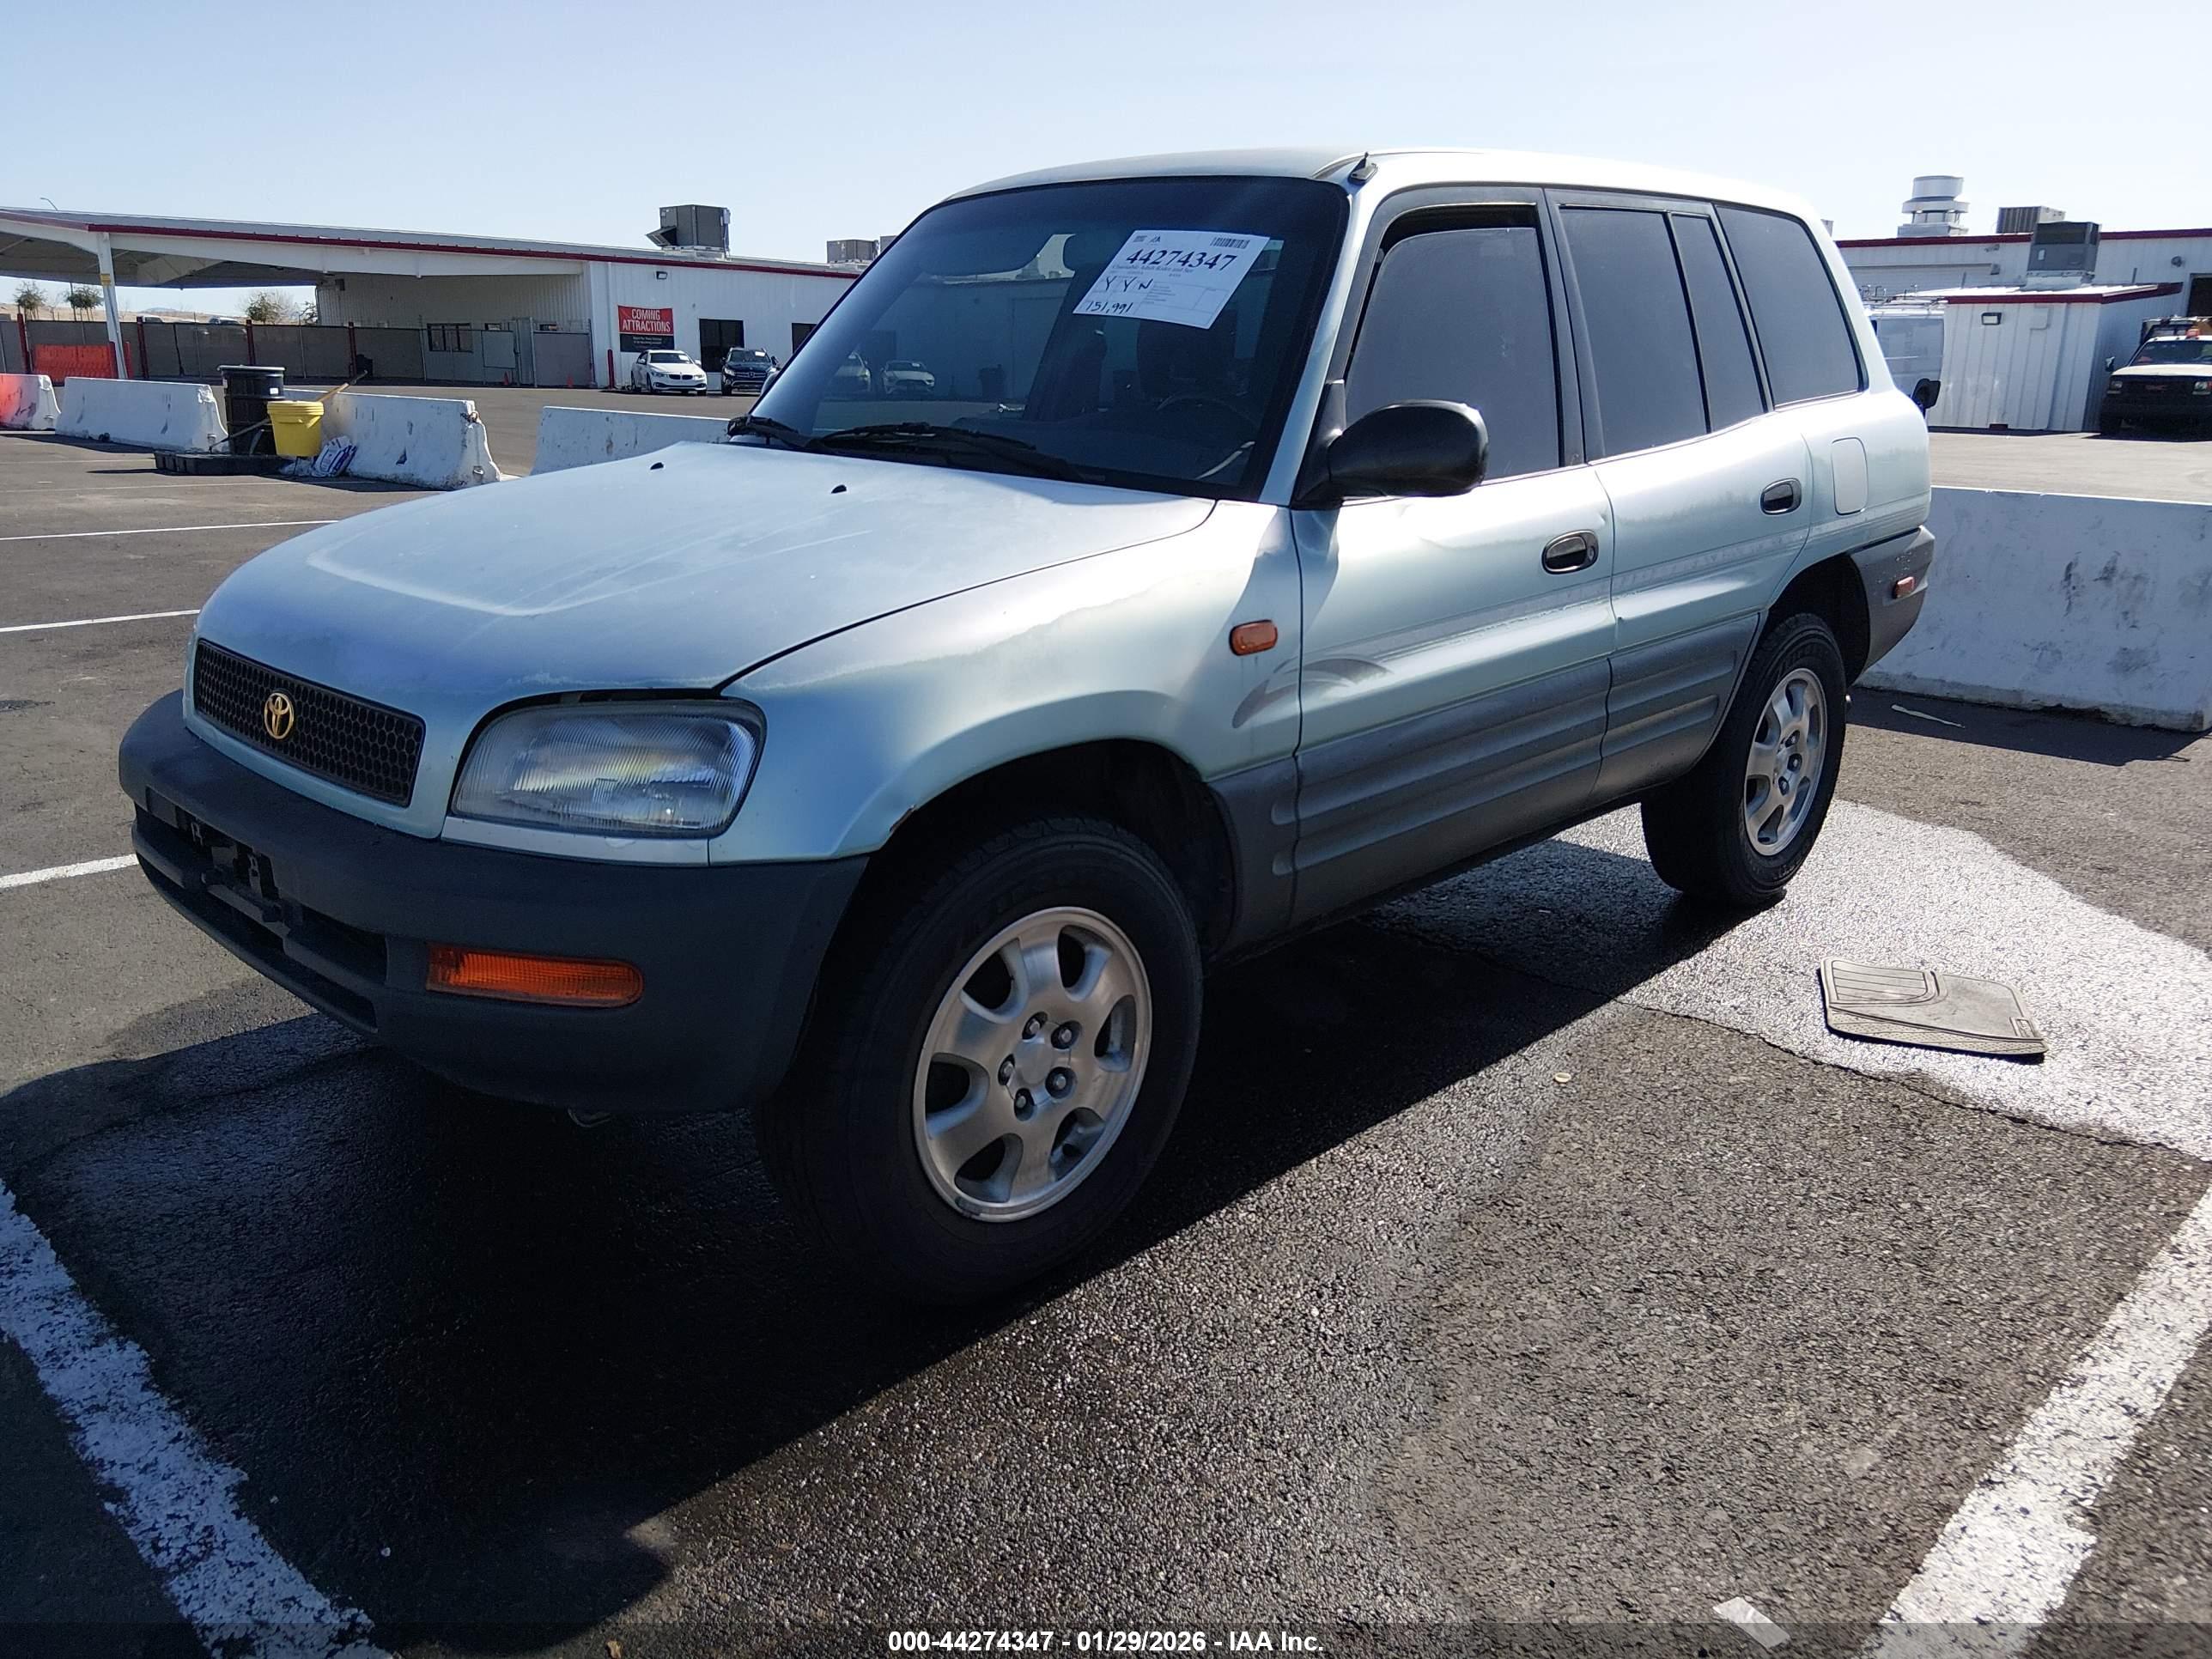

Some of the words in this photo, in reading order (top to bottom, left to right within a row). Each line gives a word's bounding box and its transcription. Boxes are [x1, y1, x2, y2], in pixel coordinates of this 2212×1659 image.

[1126, 248, 1238, 271] 44274347
[631, 308, 660, 319] COMING
[623, 319, 671, 332] ATTRACTIONS
